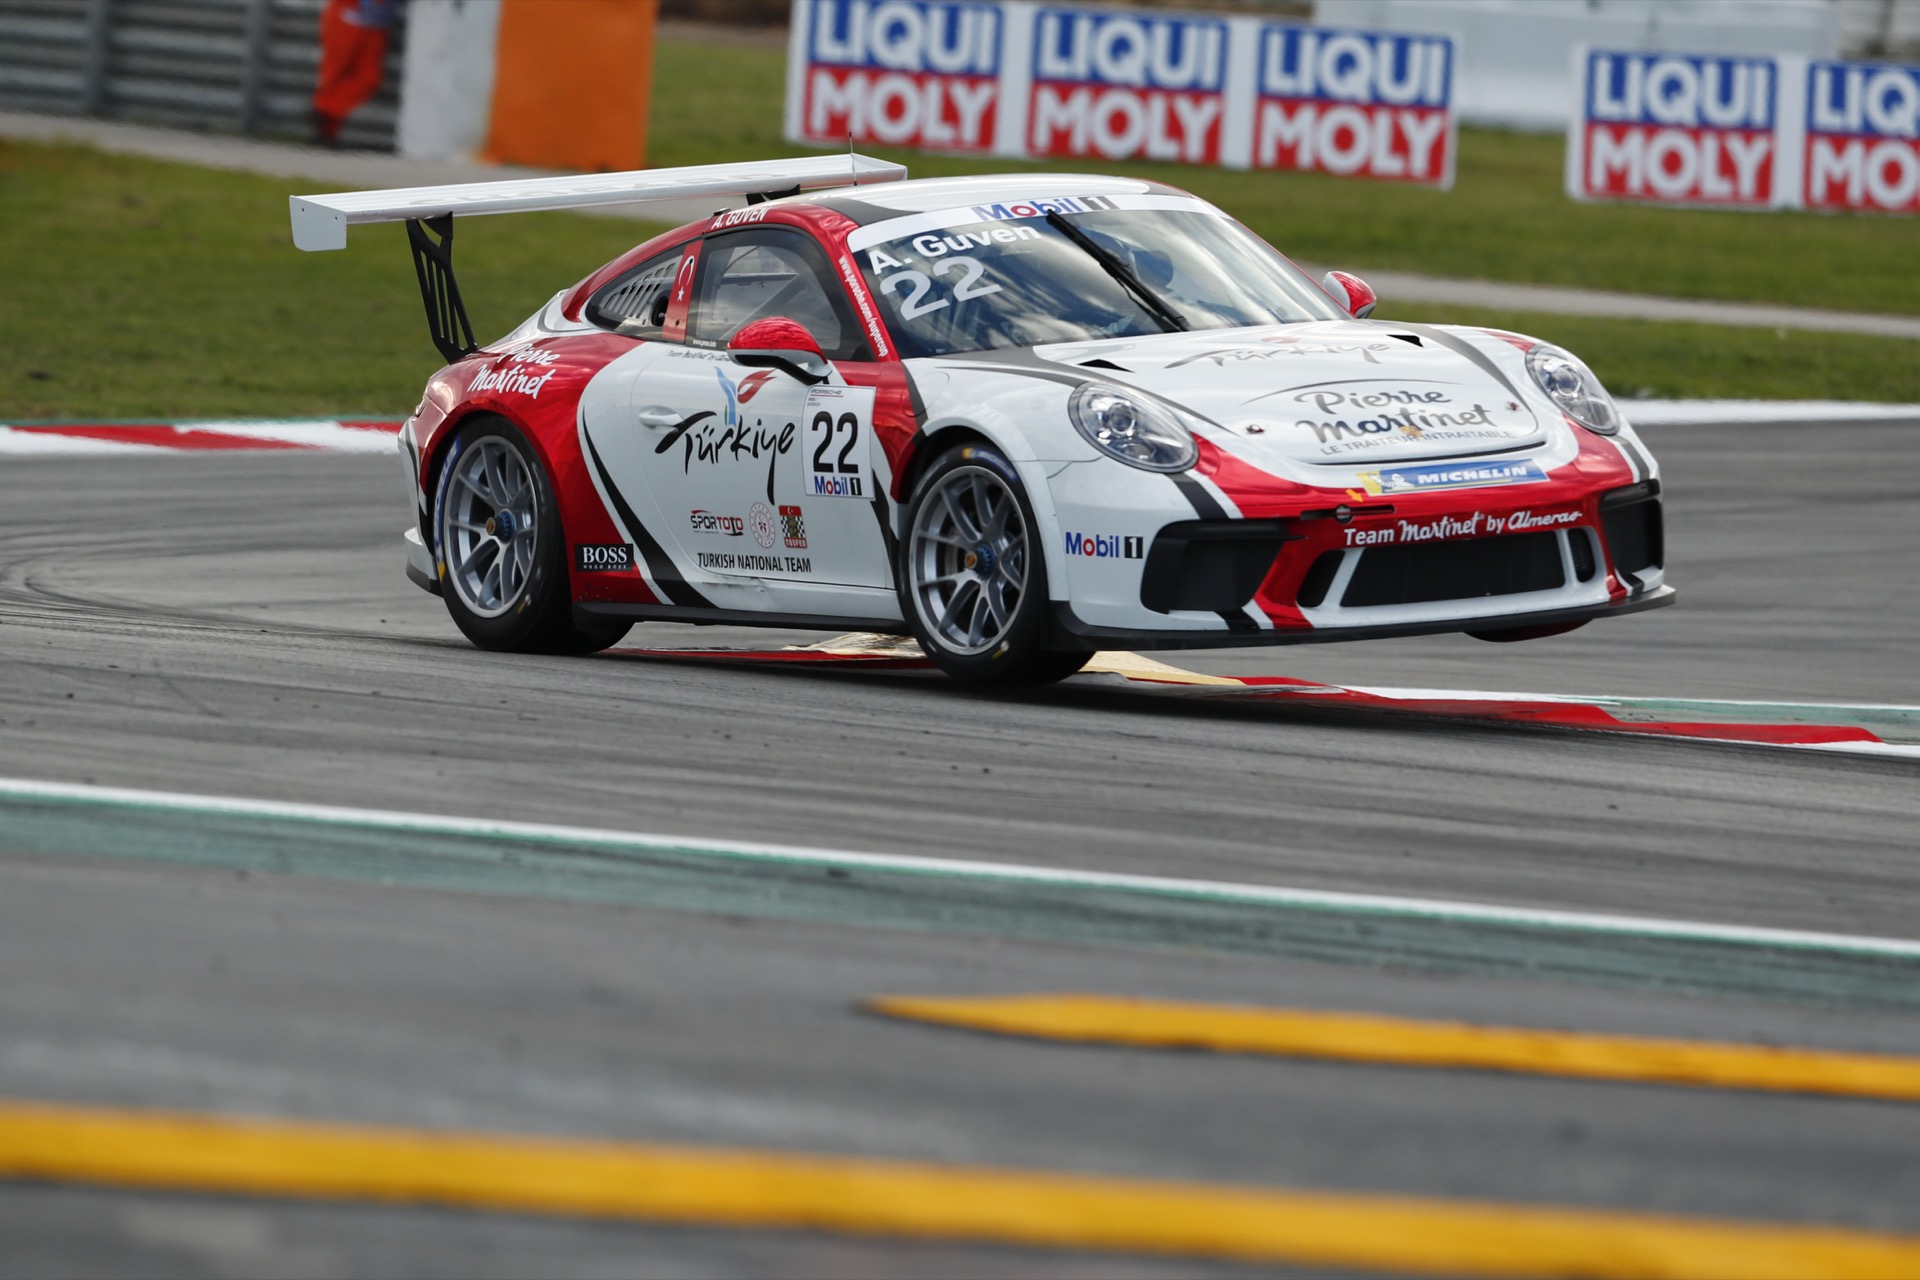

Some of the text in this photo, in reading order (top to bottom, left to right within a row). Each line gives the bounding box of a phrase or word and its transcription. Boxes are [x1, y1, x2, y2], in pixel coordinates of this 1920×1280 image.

[815, 0, 995, 73] LIQUI
[1040, 15, 1221, 89] LIQUI
[1265, 33, 1444, 105] LIQUI
[1594, 55, 1771, 127] LIQUI
[810, 69, 995, 143] MOLY
[1032, 86, 1220, 162] MOLY
[1813, 67, 1920, 138] LIQ
[1259, 103, 1443, 177] MOLY
[1590, 127, 1771, 199] MOLY
[1811, 137, 1920, 211] MO
[711, 213, 723, 230] A.
[970, 197, 1085, 222] Mobil
[868, 225, 1042, 275] A. Guven
[838, 255, 888, 357] www.porsche.com/supercup
[880, 256, 1003, 321] 22
[497, 343, 560, 366] Pierre
[1164, 343, 1391, 369] Türkiye
[467, 364, 556, 400] Martinet
[1294, 390, 1452, 415] Pierre
[655, 411, 795, 506] Türkiye
[812, 411, 859, 474] 22
[1320, 430, 1516, 456] LE TRAITEUR INTRAITABLE
[813, 475, 848, 495] Mobil
[1417, 466, 1528, 485] MICHELIN
[690, 514, 744, 534] SPORTOTO
[1065, 531, 1120, 559] Mobil
[1344, 511, 1583, 546] Team Martinet by Almeras
[582, 546, 628, 564] BOSS
[697, 552, 812, 573] TURKISH NATIONAL TEAM
